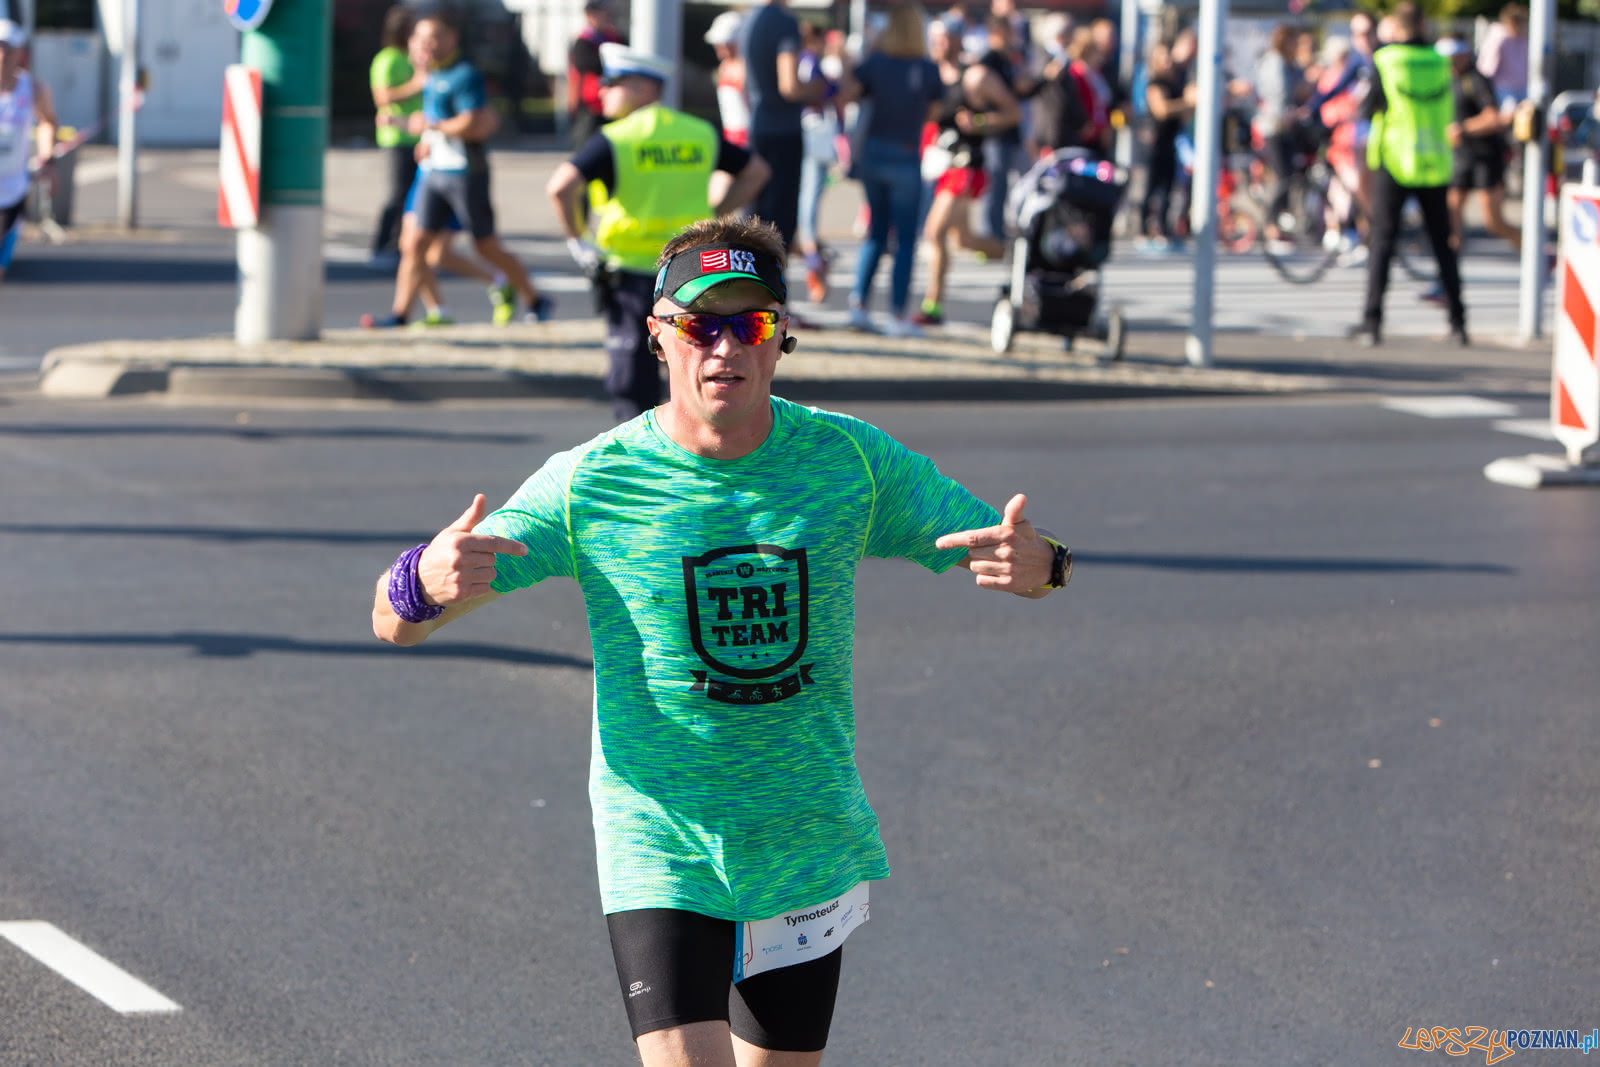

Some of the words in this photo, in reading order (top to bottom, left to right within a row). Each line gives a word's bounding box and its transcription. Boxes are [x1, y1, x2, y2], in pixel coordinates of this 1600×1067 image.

[707, 582, 788, 620] TRI
[711, 621, 789, 647] TEAM
[784, 900, 839, 927] Tymoteusz
